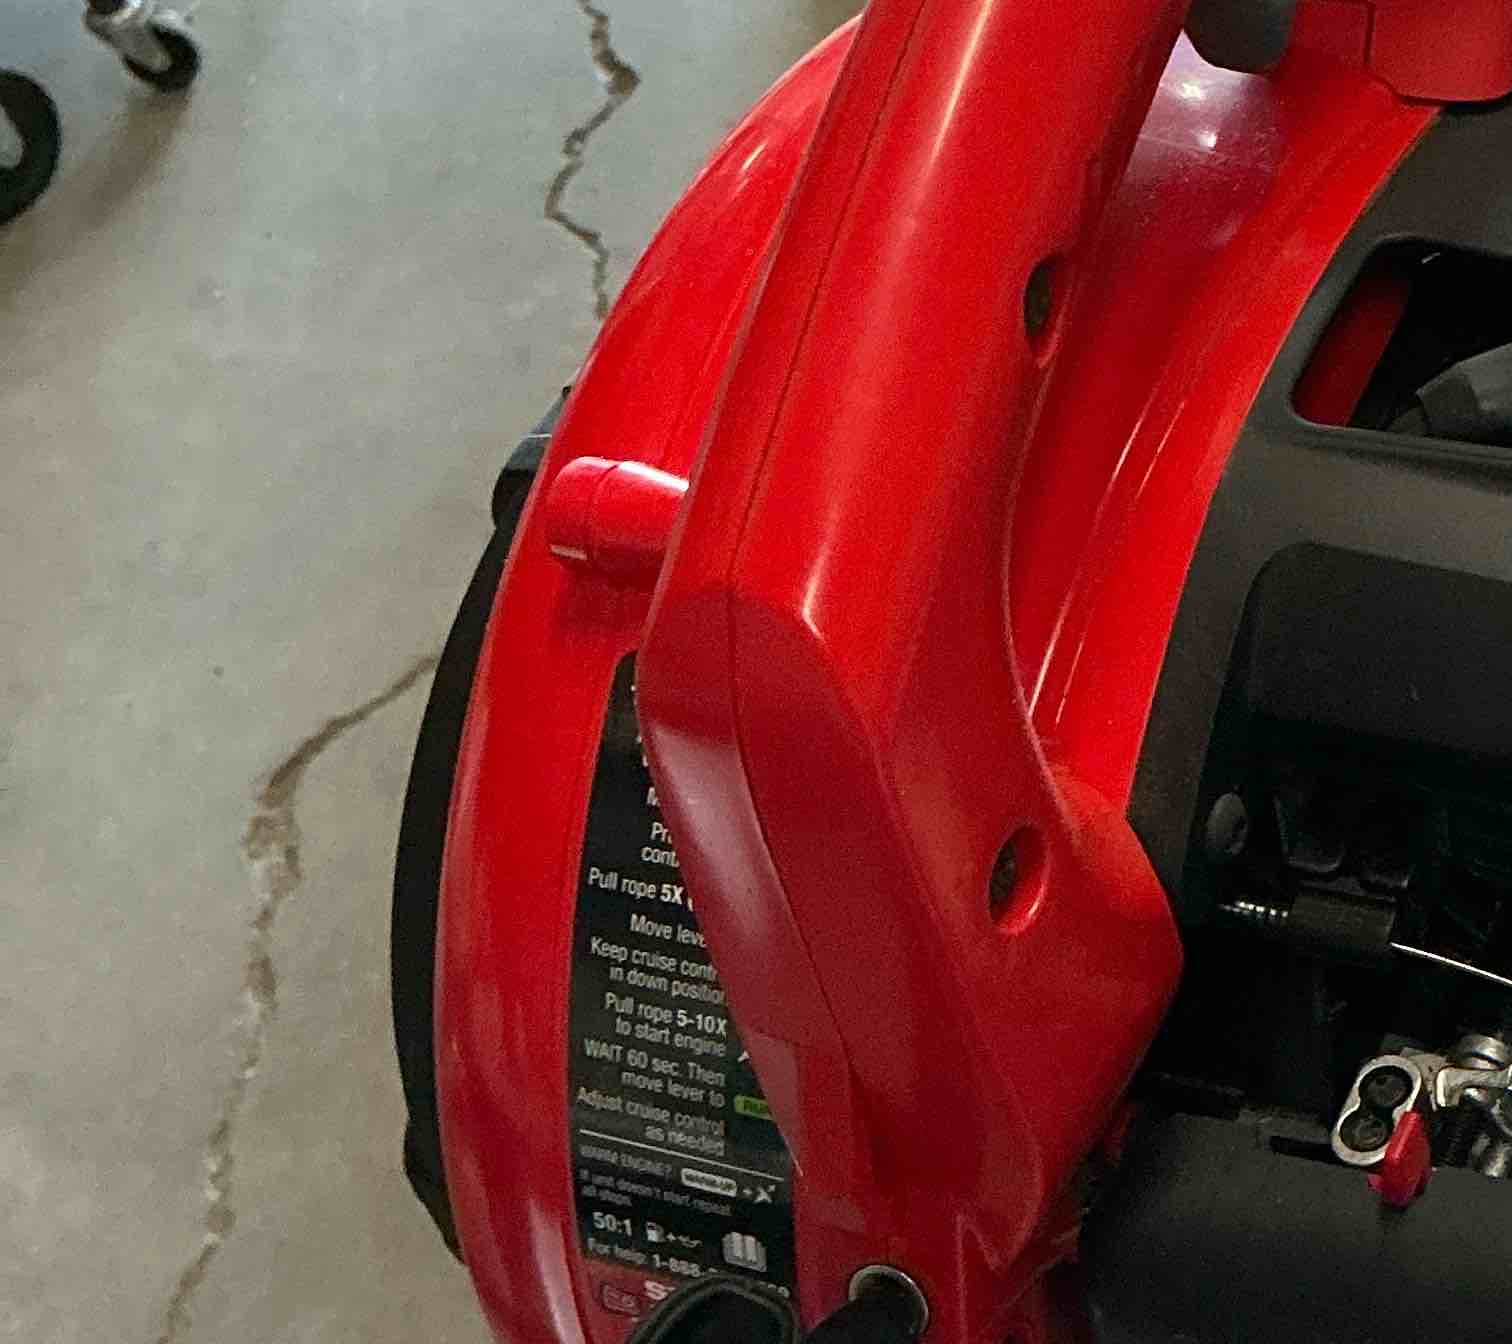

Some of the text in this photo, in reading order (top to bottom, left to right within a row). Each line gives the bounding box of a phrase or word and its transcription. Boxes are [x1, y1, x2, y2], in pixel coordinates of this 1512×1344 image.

[588, 867, 618, 891] Pull
[621, 877, 657, 900] rope
[660, 883, 684, 905] 5X
[630, 913, 672, 940] Move
[590, 936, 628, 963] Keep
[631, 949, 677, 972] cruise
[609, 965, 624, 982] in
[626, 969, 668, 993] down
[604, 992, 728, 1036] Pull rope 5-10X
[615, 1017, 727, 1057] to start engine
[584, 1038, 624, 1064] WAIT
[626, 1049, 649, 1069] 60
[687, 1061, 727, 1088] Then
[621, 1071, 727, 1109] move lever to
[576, 1086, 727, 1137] Adjust cruise control
[645, 1126, 725, 1157] as needed
[592, 1211, 632, 1236] 50:1
